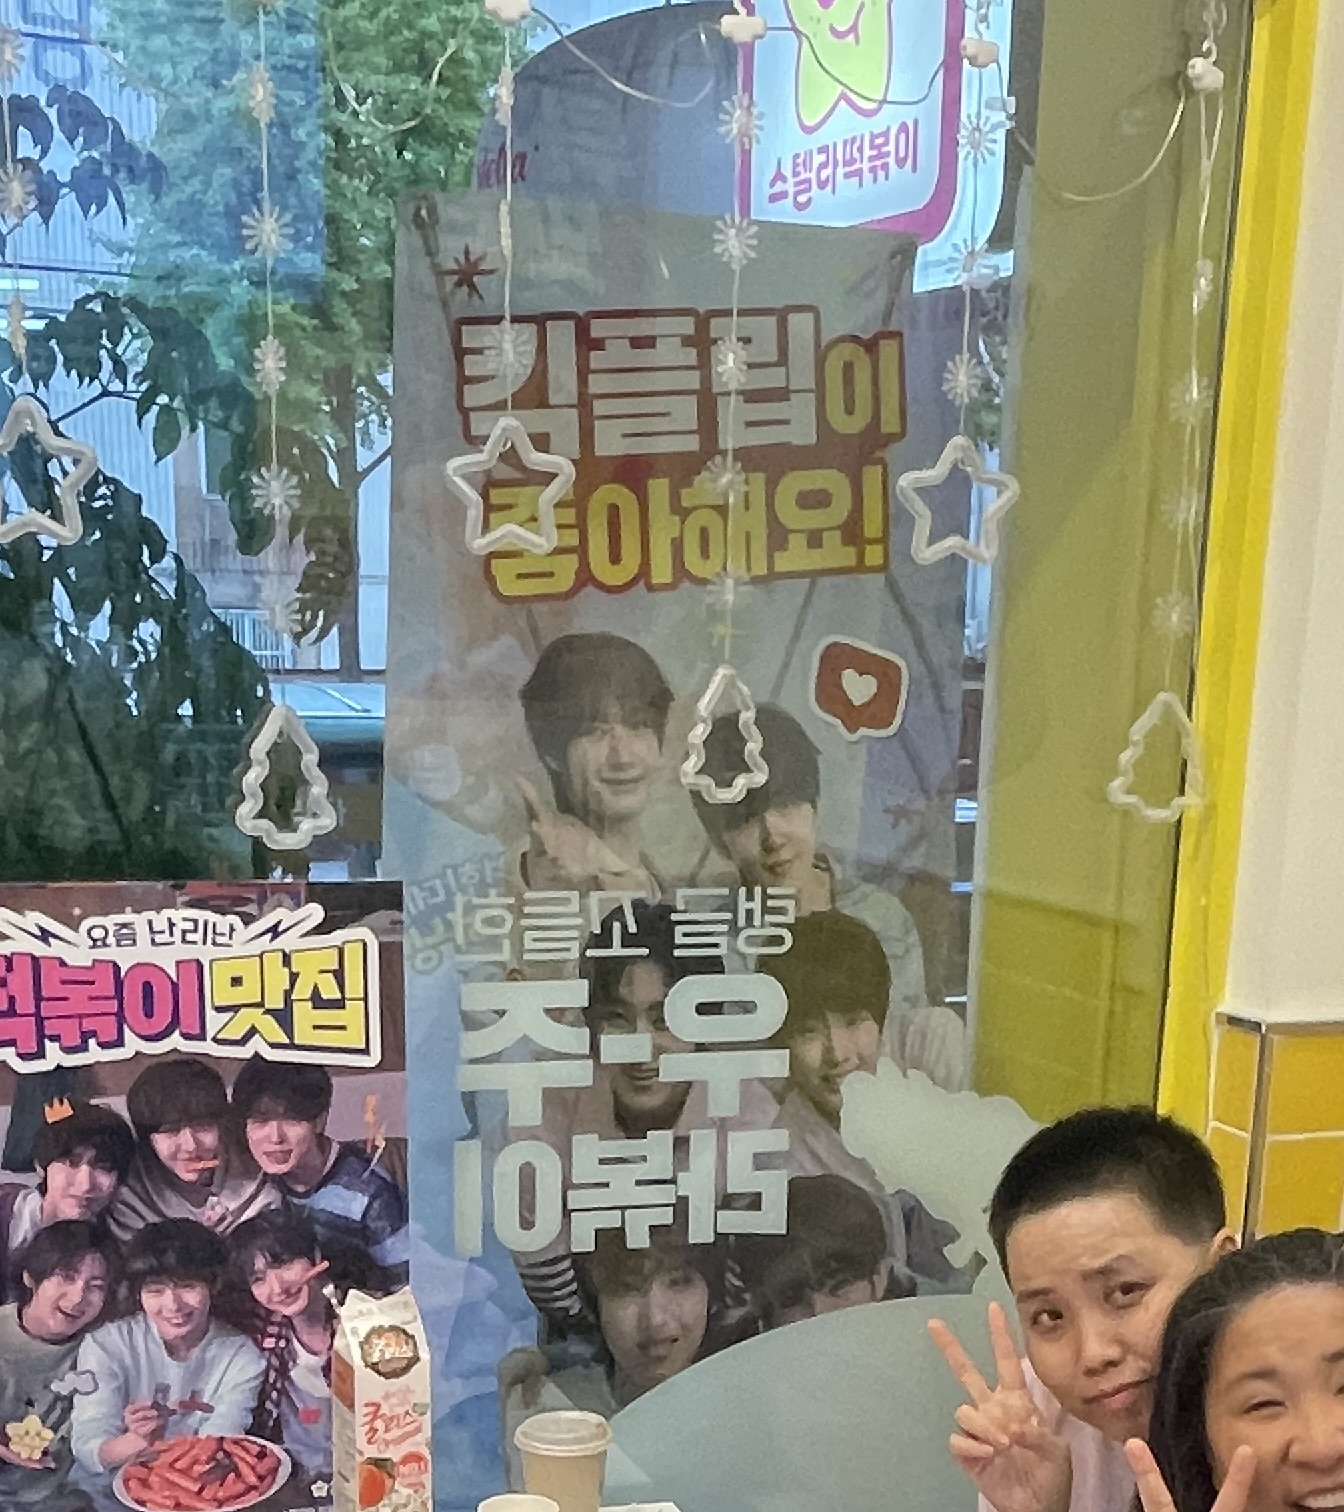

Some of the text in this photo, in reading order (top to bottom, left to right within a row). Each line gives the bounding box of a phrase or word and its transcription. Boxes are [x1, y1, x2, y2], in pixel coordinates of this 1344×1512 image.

[767, 115, 920, 212] 스텔라떡볶이
[459, 312, 902, 460] 킥플립이
[487, 463, 886, 597] 좋아해요!
[85, 916, 237, 950] 요즘 난리난
[210, 937, 372, 1055] 맛집
